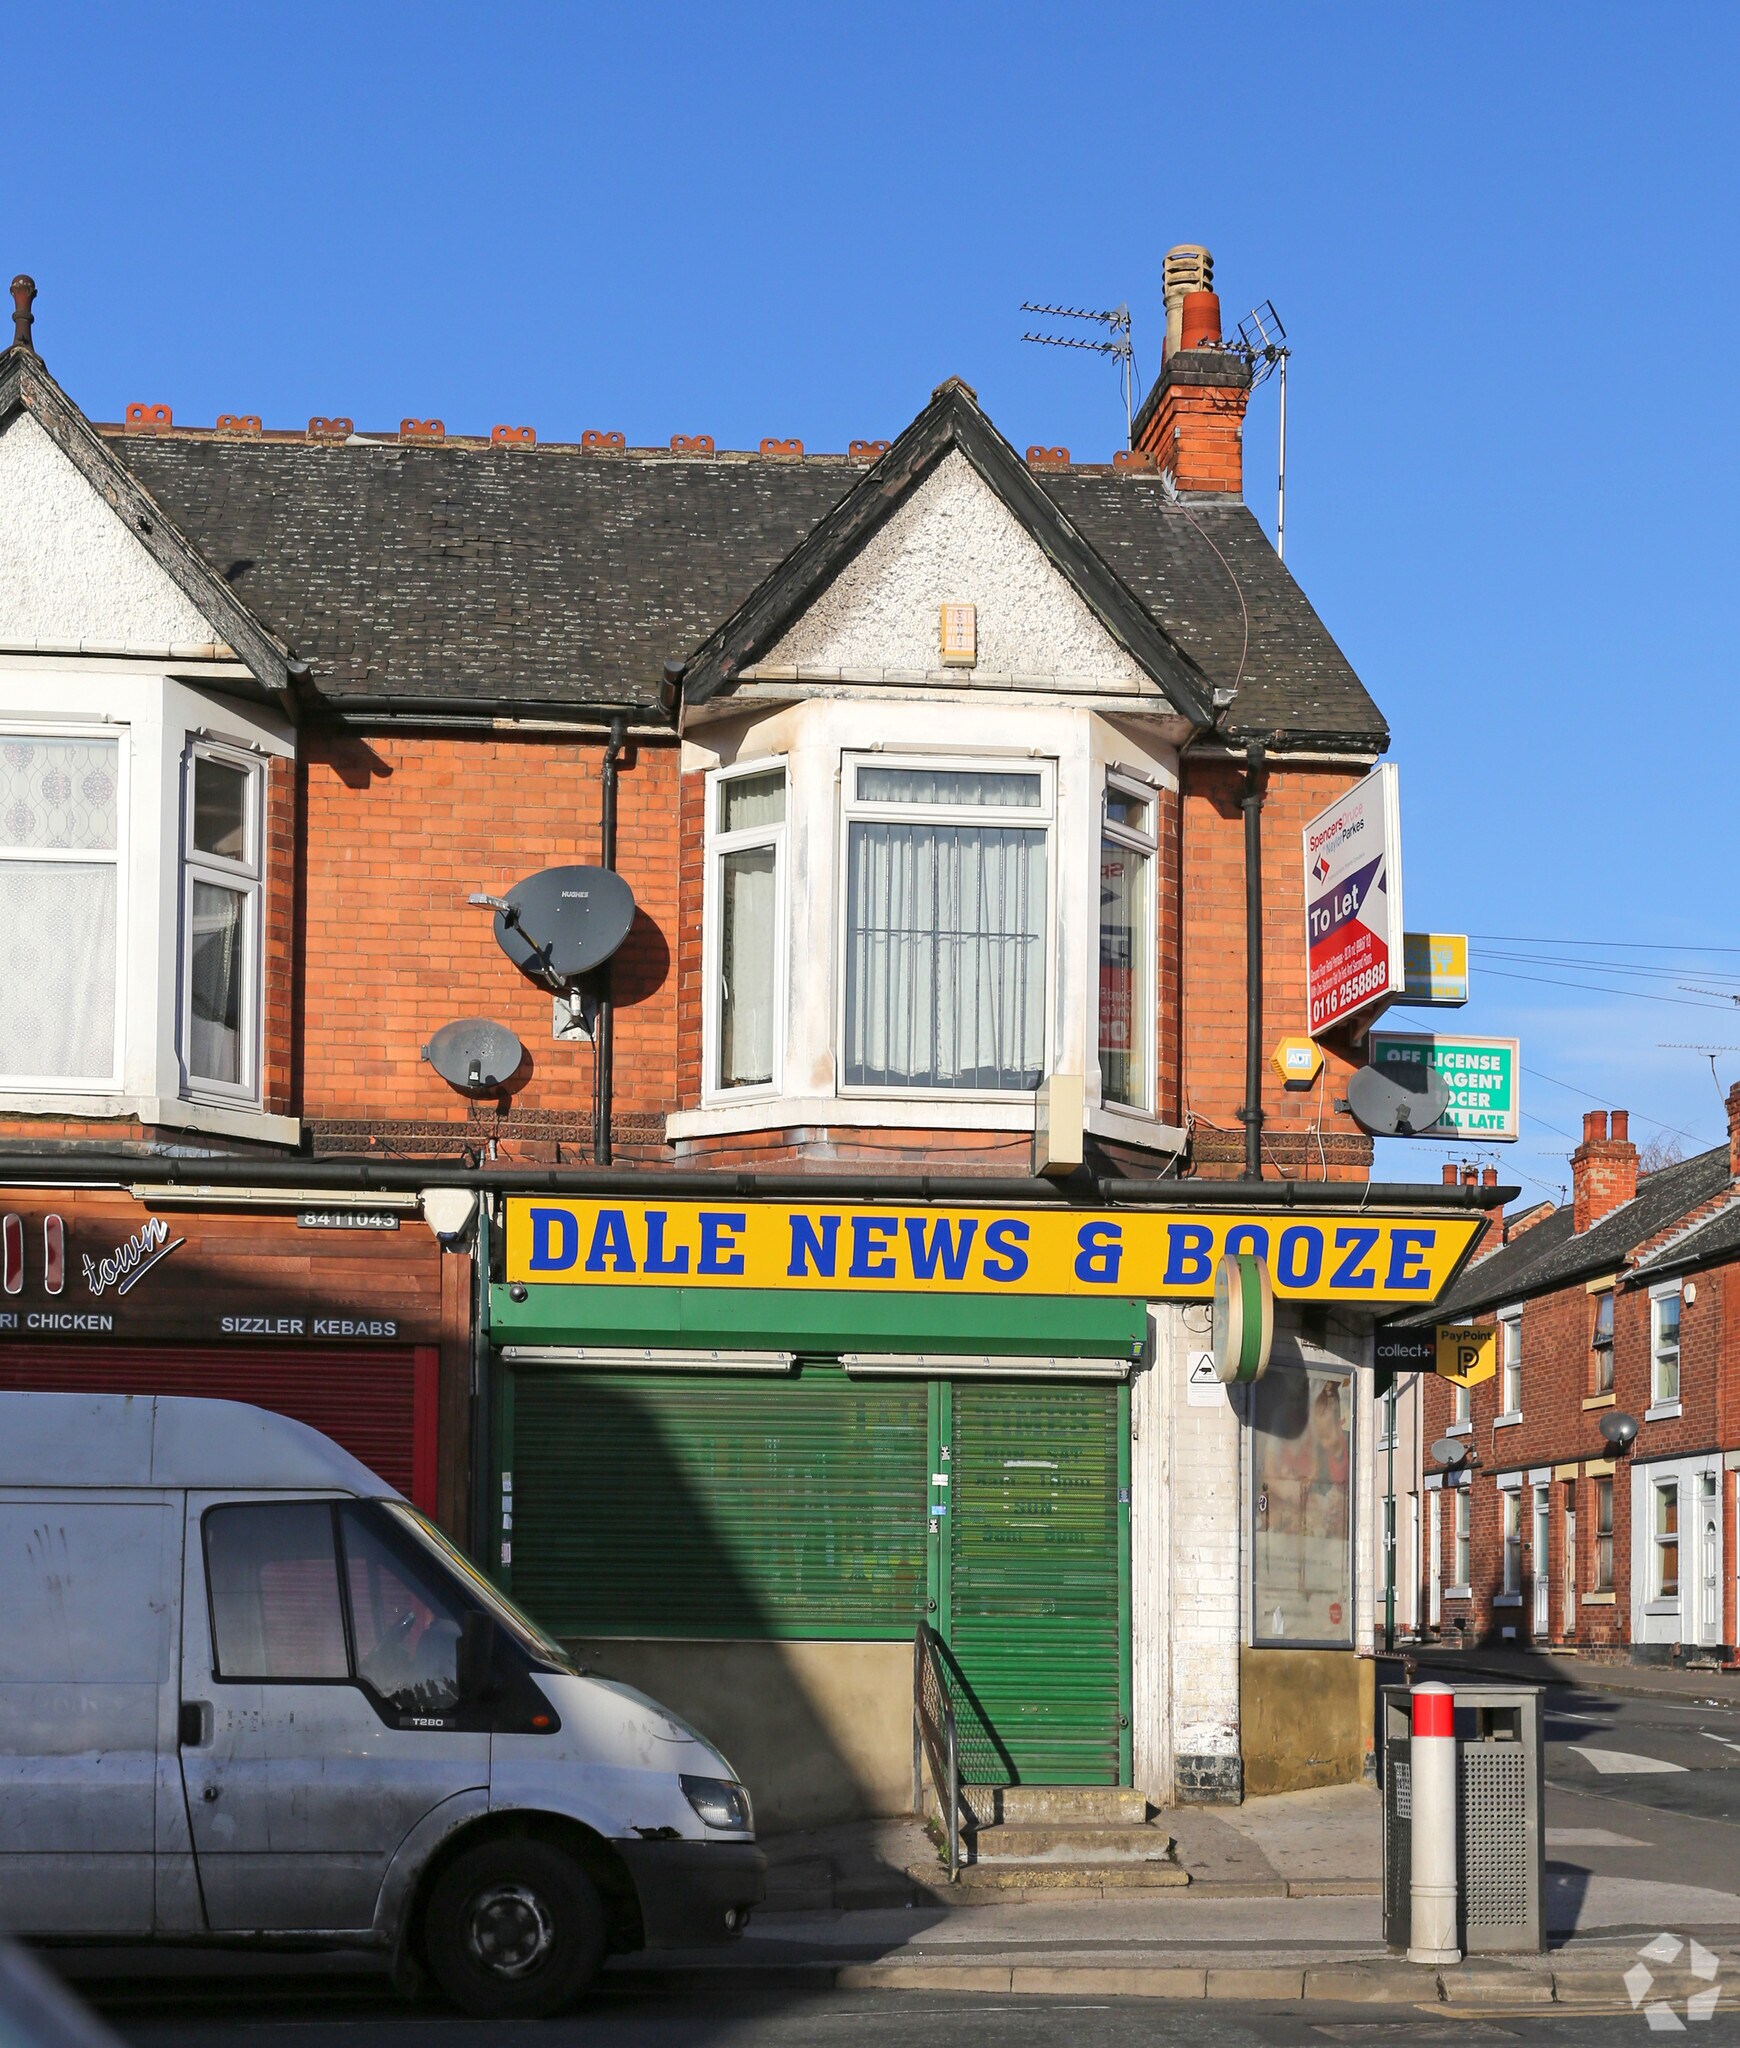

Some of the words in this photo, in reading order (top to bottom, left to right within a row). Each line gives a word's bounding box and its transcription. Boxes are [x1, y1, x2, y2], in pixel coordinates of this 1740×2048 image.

[1310, 908, 1330, 937] To
[1334, 884, 1359, 923] Let
[1313, 989, 1337, 1023] 0116
[1340, 960, 1386, 1007] 2558888
[1288, 1054, 1311, 1065] ADT
[1387, 1049, 1421, 1062] OFF
[1427, 1052, 1500, 1071] LICENSE
[1442, 1072, 1504, 1090] AGENT
[1437, 1111, 1463, 1127] ILL
[1468, 1113, 1505, 1130] LATE
[303, 1211, 396, 1228] 8411043
[529, 1207, 746, 1275] DALE
[787, 1214, 1030, 1282] NEWS
[1074, 1220, 1124, 1284] &
[82, 1216, 168, 1296] town
[27, 1313, 113, 1331] CHICKEN
[221, 1317, 304, 1334] SIZZLER
[313, 1319, 396, 1337] KEBABS
[1441, 1330, 1492, 1343] PayPoint
[1377, 1343, 1431, 1358] collect+
[412, 1718, 444, 1727] T280
